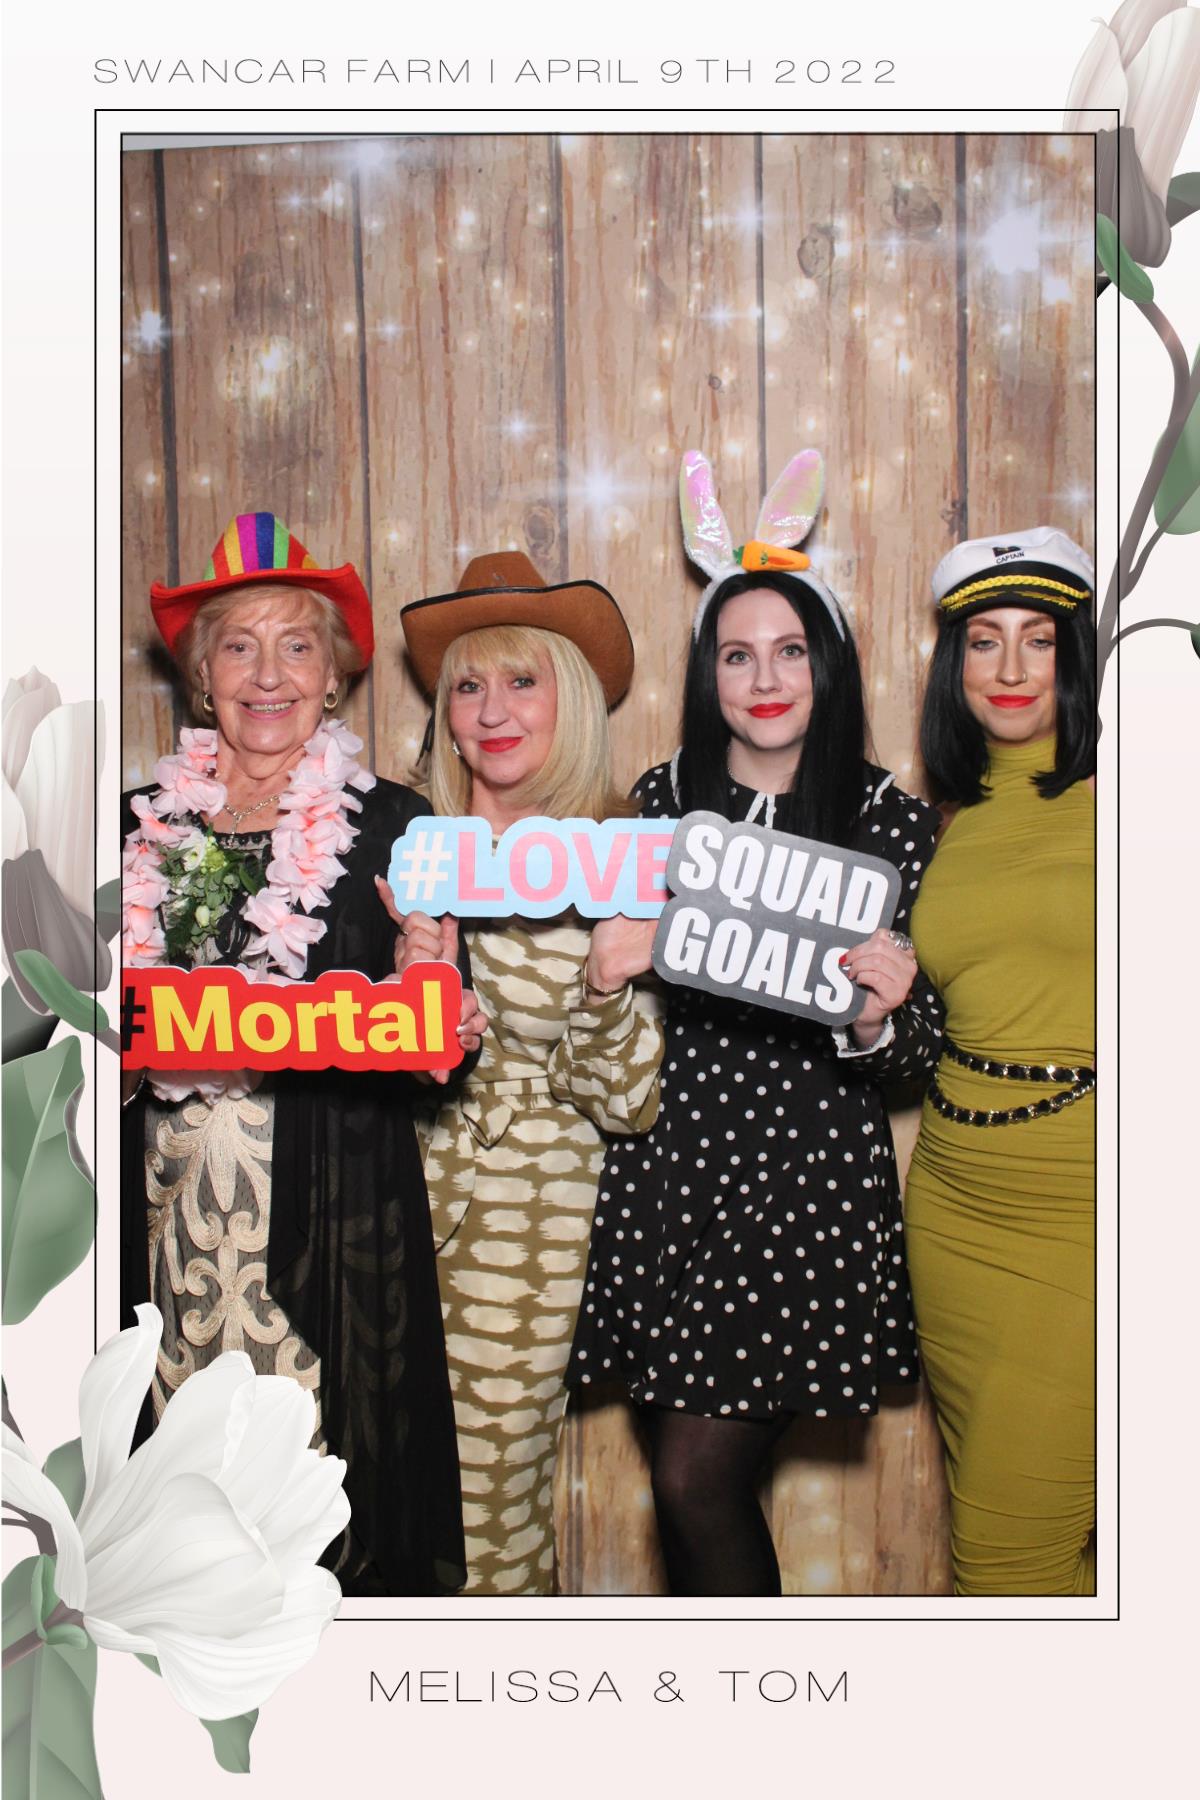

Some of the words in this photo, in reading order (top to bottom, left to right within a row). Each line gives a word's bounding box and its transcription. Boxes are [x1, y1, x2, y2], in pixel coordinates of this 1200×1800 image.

[996, 551, 1025, 564] CAPTAIN
[398, 831, 673, 903] #LOVE
[678, 824, 889, 934] SQUAD
[663, 907, 854, 1014] GOALS
